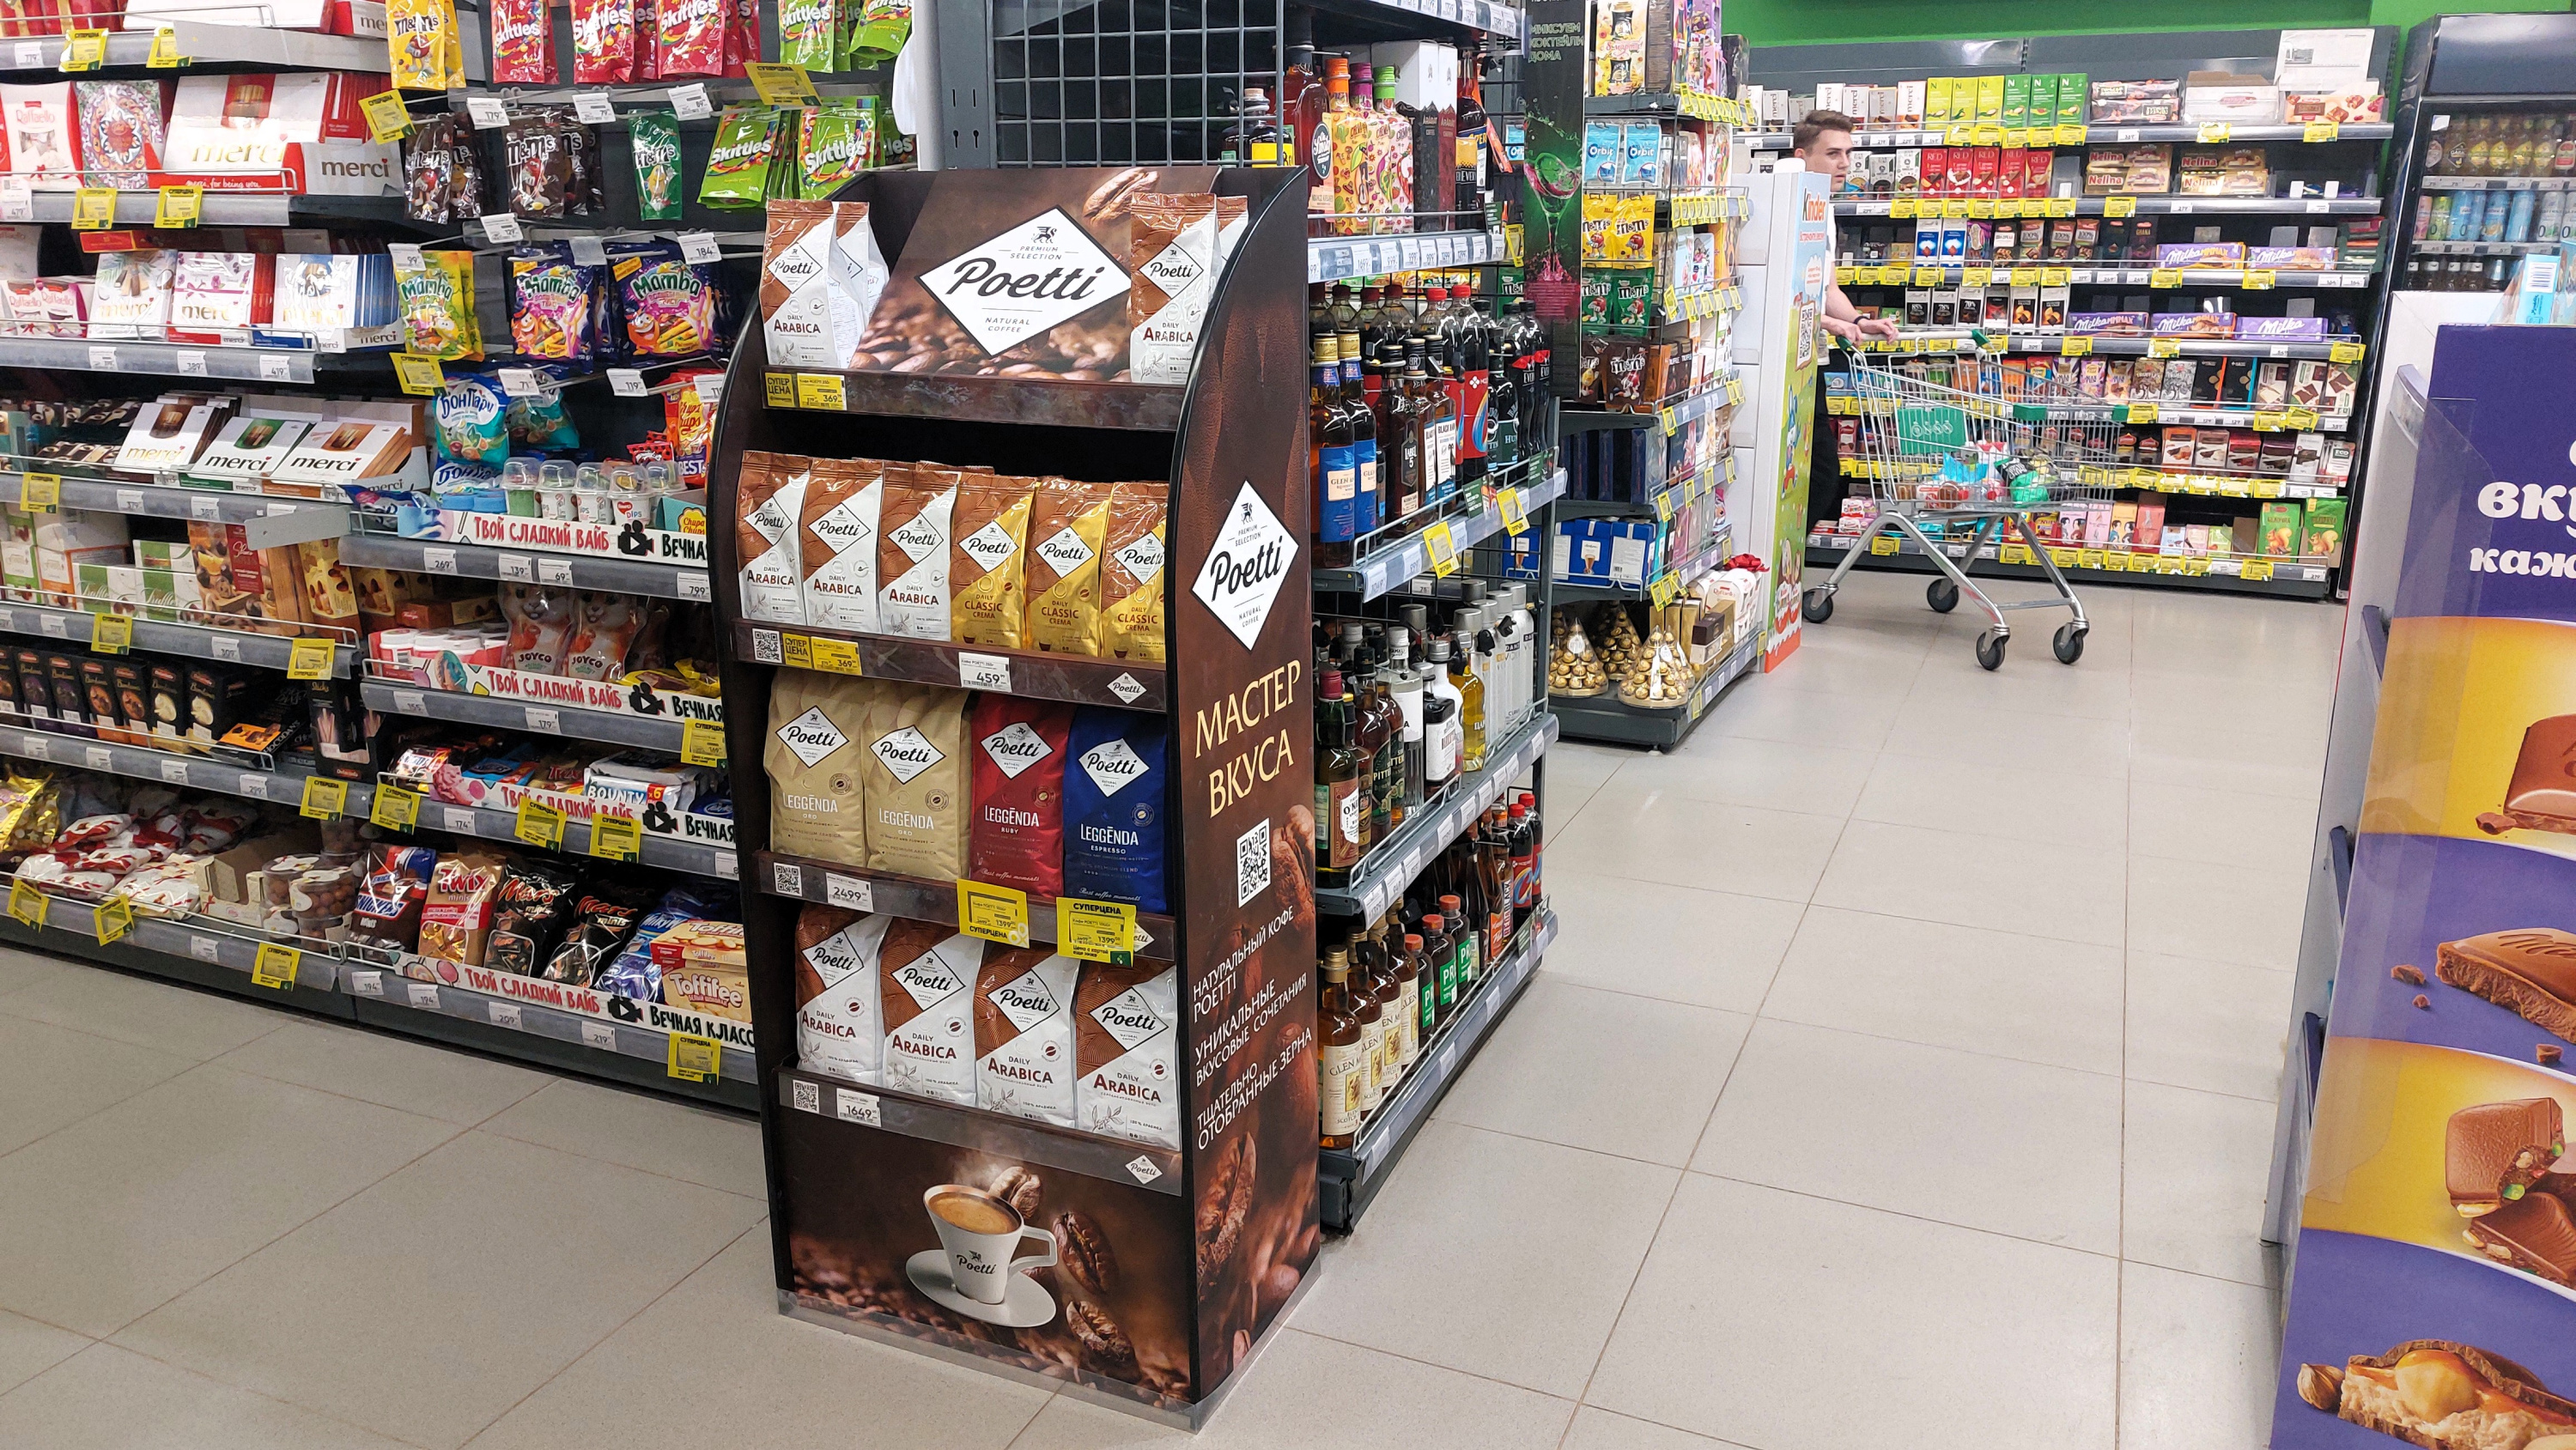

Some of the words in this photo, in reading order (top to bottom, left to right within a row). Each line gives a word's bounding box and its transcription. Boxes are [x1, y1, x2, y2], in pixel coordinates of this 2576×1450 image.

[1528, 22, 1581, 35] МИКСУЕМ
[1529, 35, 1583, 48] КОКТЕЙЛИ
[1528, 51, 1562, 64] ДОМА
[712, 139, 772, 165] Skittles
[805, 141, 867, 173] Skittles
[1588, 145, 1613, 157] Orbit
[1629, 146, 1655, 158] Orbit
[321, 158, 390, 178] merci
[696, 246, 714, 256] 184
[2166, 247, 2202, 265] Milka
[2257, 249, 2295, 264] Milka
[774, 259, 814, 276] Poetti
[1149, 261, 1194, 279] Poetti
[525, 274, 582, 301] Mamba
[631, 270, 702, 302] Mamba
[945, 258, 1106, 300] Poetti
[401, 279, 454, 301] Mamba
[773, 319, 821, 334] ARABICA
[985, 317, 1030, 325] NATURAL
[2074, 316, 2108, 334] Milka
[2157, 316, 2193, 334] Milka
[2257, 318, 2305, 338] Milka
[359, 330, 398, 345] merci
[1142, 327, 1194, 343] ARABICA
[2334, 448, 2349, 457] ECO
[205, 455, 271, 472] merci
[290, 456, 360, 473] merci
[1408, 457, 1414, 468] 5
[754, 513, 785, 529] Poetti
[817, 519, 860, 537] Poetti
[475, 516, 505, 540] ТВОЙ
[508, 520, 571, 548] СЛАДКИЙ
[575, 526, 610, 551] ВАЙБ
[897, 530, 937, 547] Poetti
[968, 537, 1012, 555] Poetti
[1044, 543, 1085, 561] Poetti
[434, 560, 449, 569] 269
[1123, 549, 1164, 566] Poetti
[746, 568, 795, 586] ARABICA
[1210, 535, 1284, 603] Poetti
[689, 585, 706, 597] 799
[813, 578, 863, 596] ARABICA
[889, 589, 940, 606] ARABICA
[964, 601, 1004, 613] CLASSIC
[1041, 607, 1079, 619] CLASSIC
[1117, 614, 1158, 624] CLASSIC
[519, 652, 552, 665] JOYCO
[571, 656, 604, 670] JOYCO
[976, 671, 1000, 684] 459
[488, 670, 519, 695] ТВОЙ
[524, 676, 586, 702] СЛАДКИЙ
[589, 683, 623, 710] ВАЙБ
[1112, 682, 1142, 694] Poetti
[1194, 659, 1302, 760] МАСТЕР
[787, 725, 838, 748] Poetti
[879, 741, 931, 763] Poetti
[990, 737, 1042, 758] Poetti
[1087, 753, 1137, 775] Poetti
[1208, 728, 1295, 819] ВКУСА
[587, 785, 645, 805] BOUNTY
[685, 815, 736, 843] ВЕЧНАЯ
[1001, 827, 1019, 835] RUBY
[1091, 845, 1127, 855] ESPRESSO
[834, 886, 861, 901] 2499
[1073, 903, 1121, 915] СУПЕРЦЕНА
[969, 925, 1008, 938] СУПЕРЦЕНА
[1097, 936, 1115, 944] 1399
[811, 946, 856, 971] Poetti
[1193, 925, 1267, 1002] НАТУРАЛЬНЫЙ
[1267, 905, 1294, 940] КОФЕ
[903, 968, 953, 992] Poetti
[465, 968, 497, 993] ТВОЙ
[501, 980, 562, 1007] СЛАДКИЙ
[566, 990, 600, 1014] ВАЙБ
[669, 973, 744, 1008] Toffifee
[1194, 971, 1237, 1024] POETTI
[999, 989, 1052, 1013] Poetti
[650, 1005, 702, 1036] ВЕЧНАЯ
[801, 1010, 856, 1038] ARABICA
[816, 1010, 835, 1020] DAILY
[1102, 1006, 1157, 1031] Poetti
[1194, 978, 1276, 1067] УНИКАЛЬНЫЕ
[912, 1033, 934, 1042] DAILY
[1196, 1025, 1250, 1089] ВКУСОВЫЕ
[1253, 971, 1308, 1033] СОЧЕТАНИЯ
[891, 1034, 957, 1059] ARABICA
[1008, 1055, 1030, 1065] DAILY
[1330, 1060, 1355, 1077] GLEN
[987, 1057, 1054, 1084] ARABICA
[1116, 1072, 1139, 1083] DAILY
[1093, 1073, 1162, 1103] ARABICA
[1197, 1062, 1258, 1131] ТЩАТЕЛЬНО
[1198, 1062, 1279, 1151] ОТОБРАННЫЕ
[1279, 1027, 1313, 1071] ЗЕРНА
[846, 1105, 872, 1119] 1649
[1130, 1163, 1157, 1177] Poetti
[956, 1253, 996, 1275] Poetti
